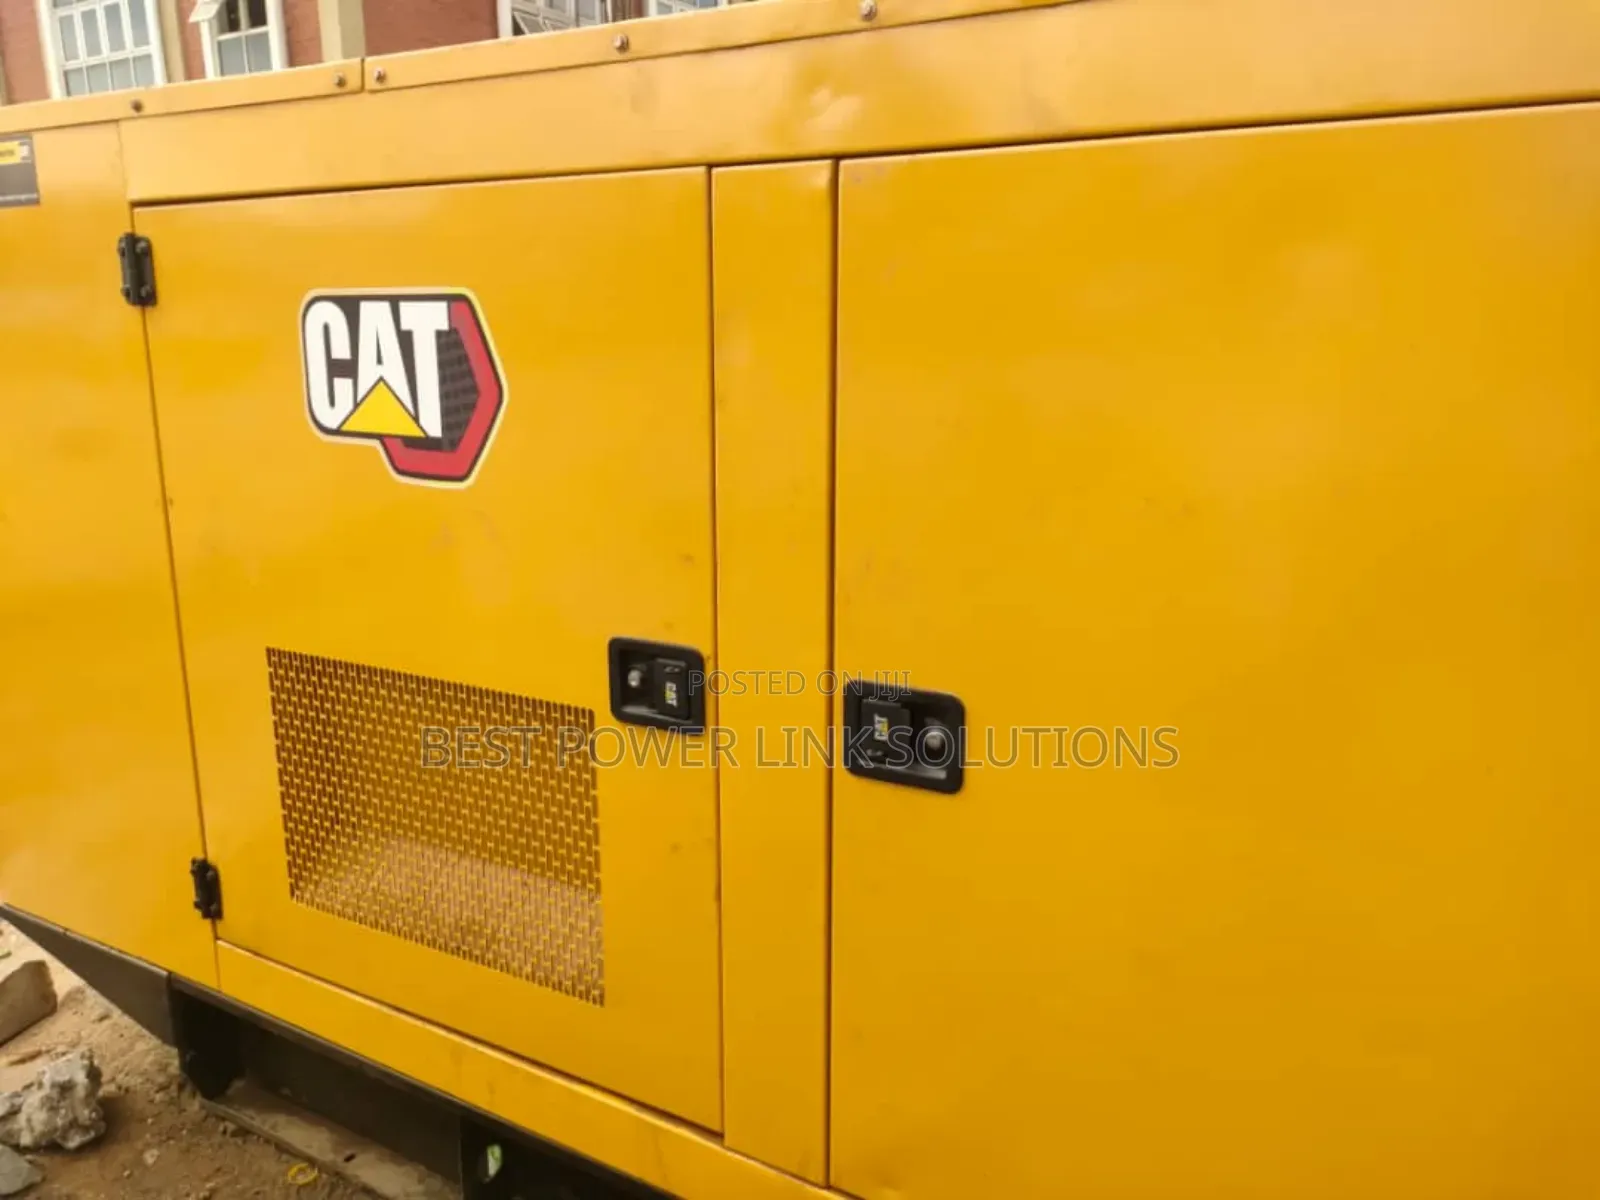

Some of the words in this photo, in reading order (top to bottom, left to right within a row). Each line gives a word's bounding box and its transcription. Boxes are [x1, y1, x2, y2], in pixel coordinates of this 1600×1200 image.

[304, 300, 450, 438] CAT
[664, 681, 678, 708] CAT
[873, 713, 889, 741] CAT
